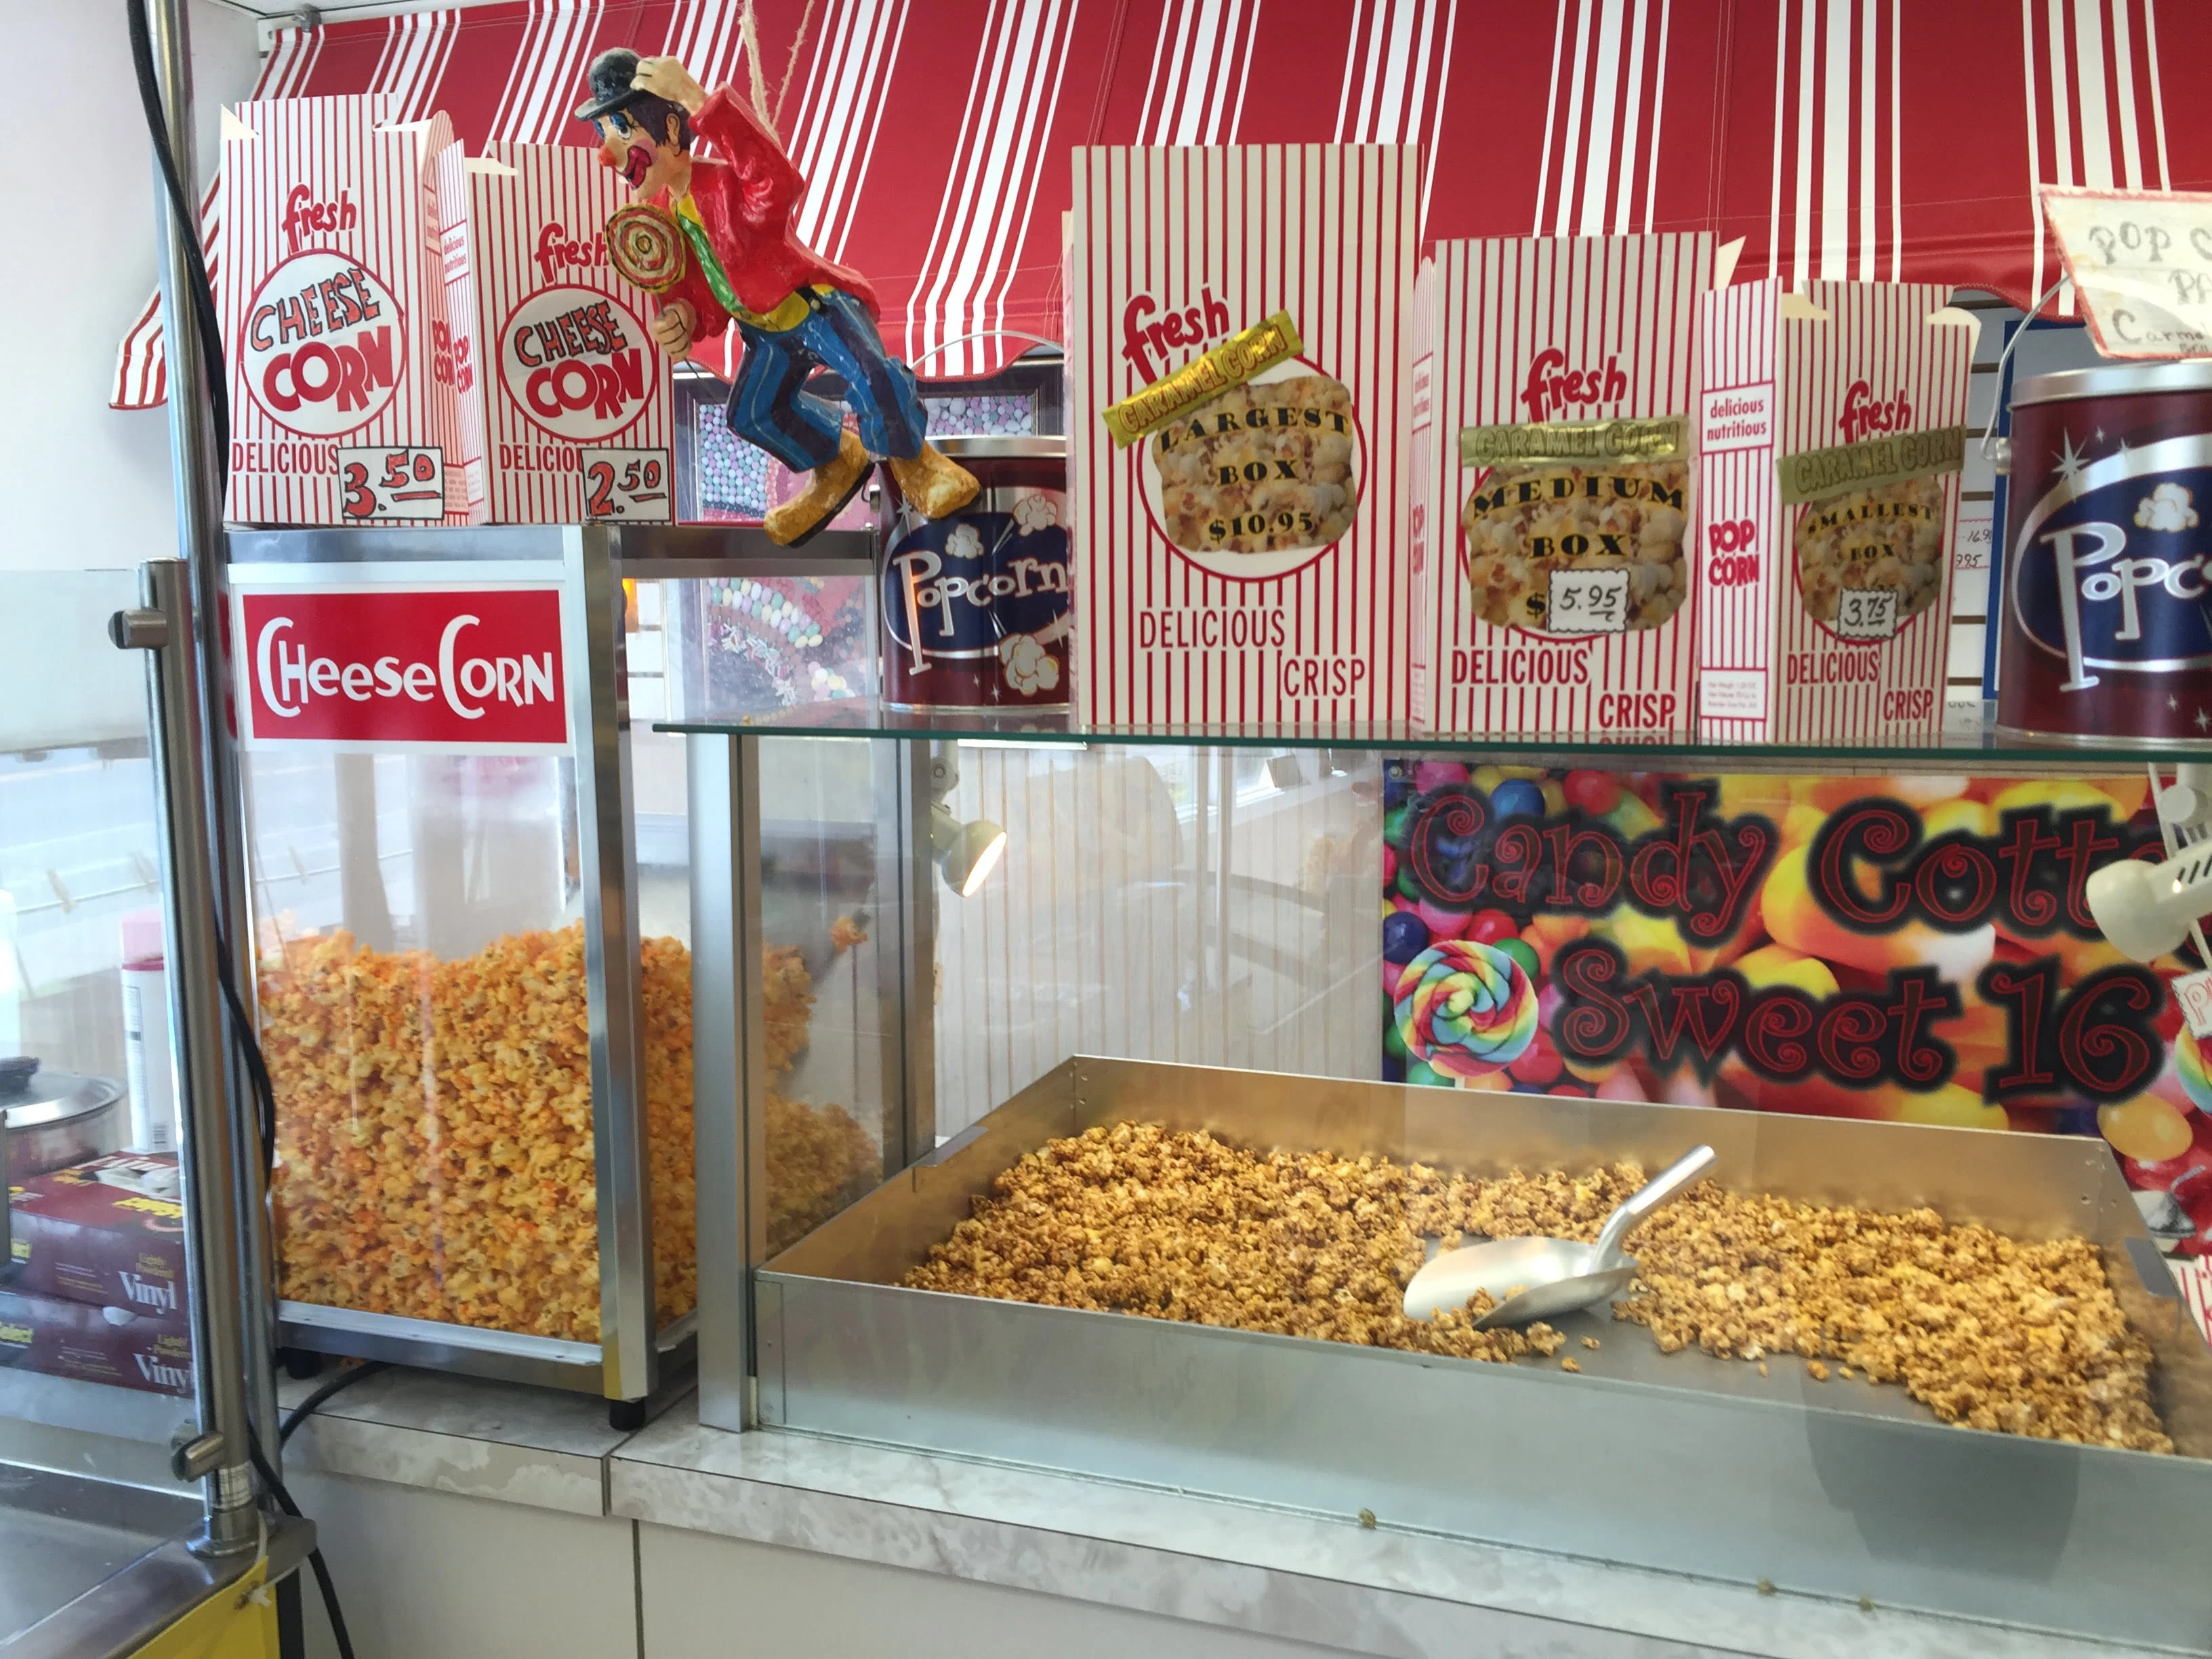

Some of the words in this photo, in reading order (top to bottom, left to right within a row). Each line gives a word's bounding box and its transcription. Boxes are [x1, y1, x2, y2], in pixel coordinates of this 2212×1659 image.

[281, 184, 357, 253] fresh
[534, 222, 609, 284] fresh
[2089, 221, 2173, 264] POP
[250, 268, 381, 352] CHEESE
[514, 300, 628, 368] CHEESE
[1122, 287, 1230, 386] fresh
[262, 325, 394, 413] CORN
[526, 348, 644, 419] CORN
[1118, 356, 1228, 434] CARAMEL
[1221, 324, 1288, 378] CORN
[1521, 348, 1627, 423] fresh
[1711, 398, 1764, 419] delicious
[1839, 380, 1912, 445] fresh
[1160, 407, 1350, 455] LARGEST
[1476, 426, 1600, 462] CARAMEL
[1605, 420, 1681, 457] CORN
[1707, 420, 1767, 441] nutritious
[232, 442, 339, 474] DELICIOUS
[1217, 459, 1299, 487] BOX
[1795, 441, 1899, 495] CARAMEL
[1900, 426, 1963, 472] CORN
[343, 449, 435, 518] 3.50
[588, 458, 661, 516] 2.50
[1473, 476, 1685, 520] MEDIUM
[1208, 512, 1314, 544] $10.95
[1708, 519, 1755, 556] POP
[1807, 502, 1933, 535] SMALLEST
[1530, 533, 1626, 558] BOX
[1851, 543, 1895, 561] BOX
[1708, 554, 1760, 586] CORN
[893, 550, 1068, 676] Popcorn
[1559, 586, 1622, 611] 5.95
[1844, 596, 1893, 628] 3.75
[2039, 522, 2212, 693] Popc
[1140, 609, 1286, 649] DELICIOUS
[1284, 659, 1366, 697] CRISP
[1452, 649, 1589, 684] DELICIOUS
[1787, 651, 1881, 684] DELICIOUS
[1598, 693, 1676, 728] CRISP
[1883, 689, 1933, 722] CRISP
[1411, 791, 1769, 938] Candy
[1820, 807, 2169, 928] Cott
[1563, 949, 1948, 1080] Sweet
[1990, 972, 2152, 1092] 16
[118, 1270, 178, 1315] Vinyl
